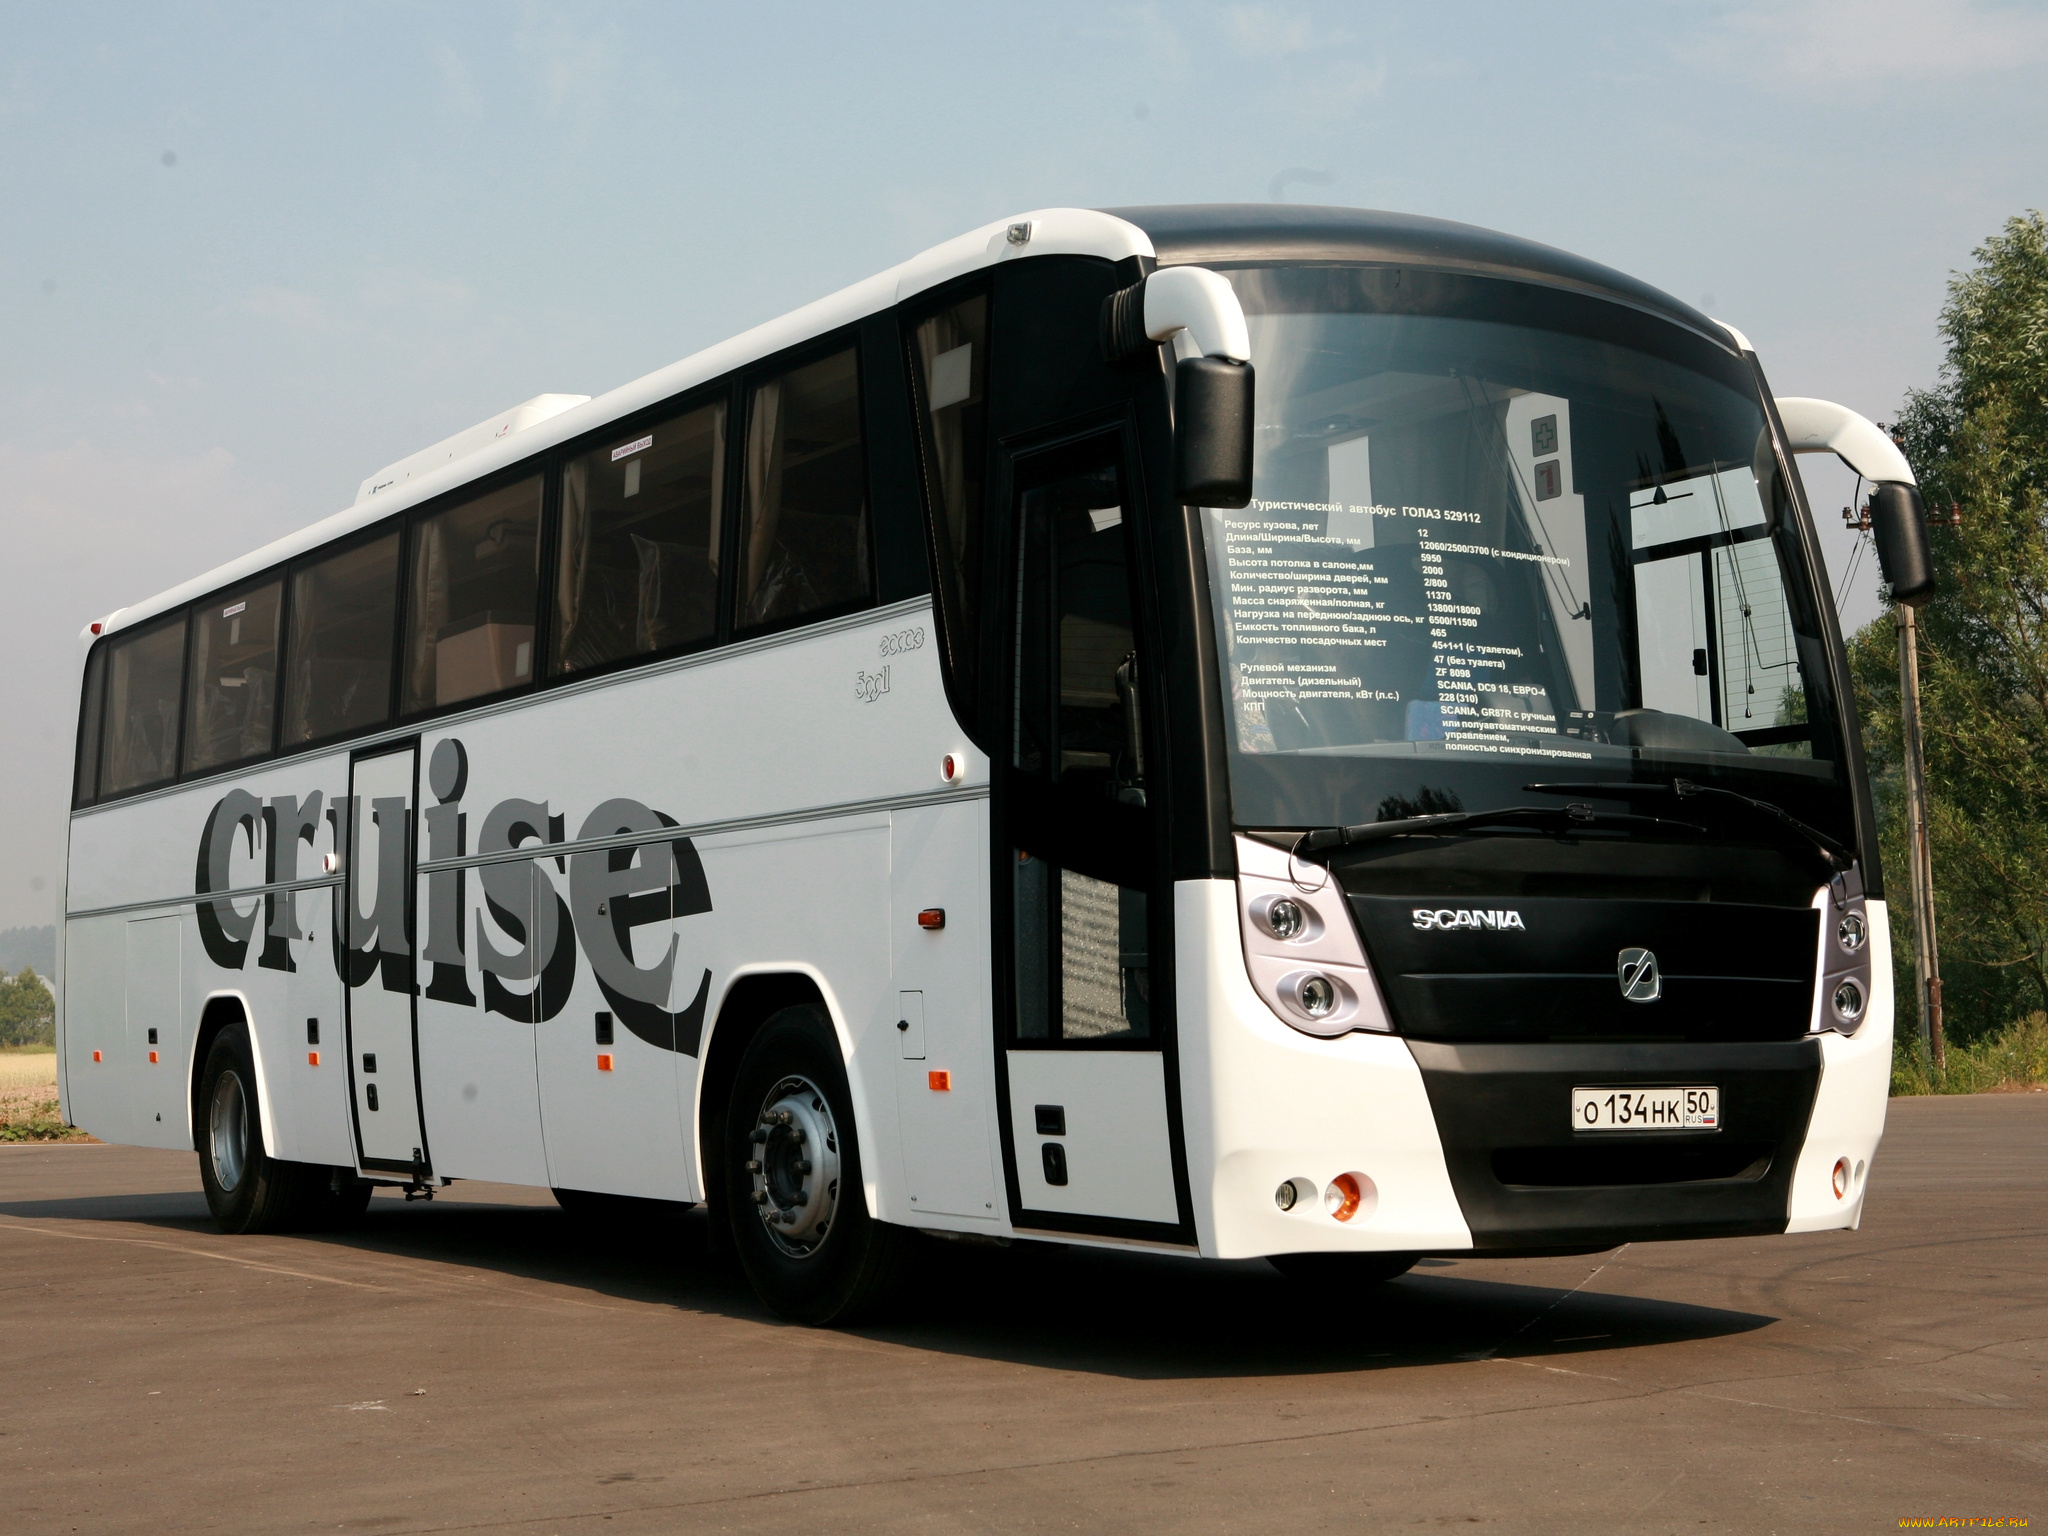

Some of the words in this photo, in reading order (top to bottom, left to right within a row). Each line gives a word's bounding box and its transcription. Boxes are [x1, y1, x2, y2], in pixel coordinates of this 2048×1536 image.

[1251, 499, 1343, 512] Туристический
[1350, 504, 1397, 517] автобус
[1402, 506, 1441, 519] ГОЛАЗ
[1444, 510, 1481, 523] 529112
[1224, 520, 1261, 530] Ресурс
[1263, 522, 1300, 531] кузова,
[1302, 522, 1319, 530] лет
[1225, 532, 1345, 545] Длина/Ширина/Высота,
[1346, 537, 1361, 545] мм
[1418, 528, 1428, 538] 12
[1227, 545, 1255, 555] База,
[1419, 541, 1489, 555] 12060/2500/3700
[1491, 547, 1500, 558] (с
[1502, 550, 1570, 567] кондиционером)
[1420, 553, 1442, 563] 5950
[1228, 558, 1268, 567] Высота
[1271, 559, 1311, 568] потолка
[1313, 560, 1320, 568] в
[1322, 561, 1374, 571] салоне,мм
[1422, 566, 1444, 576] 2000
[1230, 571, 1332, 582] Количество/ширина
[1334, 573, 1372, 584] дверей,
[1424, 578, 1448, 588] 2/800
[1231, 583, 1256, 593] Мин.
[1259, 585, 1295, 594] радиус
[1297, 586, 1351, 596] разворота,
[1353, 588, 1368, 596] мм
[1426, 591, 1452, 601] 11370
[1232, 596, 1265, 605] Масса
[1267, 597, 1374, 609] снаряженная/полная,
[1376, 601, 1385, 609] кг
[1427, 603, 1481, 615] 13800/18000
[1234, 609, 1280, 619] Нагрузка
[1282, 610, 1295, 618] на
[1297, 610, 1391, 622] переднюю/заднюю
[1393, 614, 1414, 624] ось,
[1428, 616, 1478, 627] 6500/11500
[1235, 622, 1279, 631] Емкость
[1281, 623, 1340, 632] топливного
[1342, 624, 1368, 634] бака,
[1369, 626, 1376, 634] л
[1430, 628, 1447, 638] 465
[1236, 634, 1298, 644] Количество
[1300, 636, 1362, 646] посадочных
[1364, 638, 1388, 647] мест
[1432, 641, 1463, 651] 45+1+1
[1466, 643, 1475, 654] (с
[1476, 645, 1524, 658] туалетом).
[1240, 663, 1285, 674] Рулевой
[1287, 664, 1337, 673] механизм
[1434, 655, 1444, 664] 47
[1446, 656, 1466, 666] (без
[1467, 658, 1506, 670] туалета)
[1435, 667, 1448, 677] ZF
[1449, 668, 1471, 678] 8098
[1241, 676, 1296, 686] Двигатель
[1298, 676, 1362, 688] (дизельный)
[1437, 680, 1476, 692] SCANIA,
[1478, 682, 1497, 692] DC9
[1499, 686, 1512, 694] 18,
[1242, 690, 1297, 700] Мощность
[1298, 690, 1354, 700] двигателя,
[1356, 690, 1374, 699] кВт
[1375, 690, 1400, 701] (л.с.)
[1438, 693, 1455, 702] 228
[1456, 694, 1478, 704] (310)
[1243, 702, 1266, 711] КПП
[1440, 706, 1480, 717] SCANIA,
[1481, 708, 1512, 718] GR87R
[1520, 712, 1556, 722] ручным
[1442, 720, 1460, 728] или
[1461, 720, 1556, 734] полуавтоматическим
[1445, 731, 1510, 742] управлением,
[1445, 743, 1498, 753] полностью
[1499, 745, 1592, 760] синхронизированная
[195, 738, 713, 1058] cruise
[1412, 909, 1526, 931] SCANIA
[1687, 1091, 1709, 1114] 50
[1686, 1116, 1702, 1124] RUS
